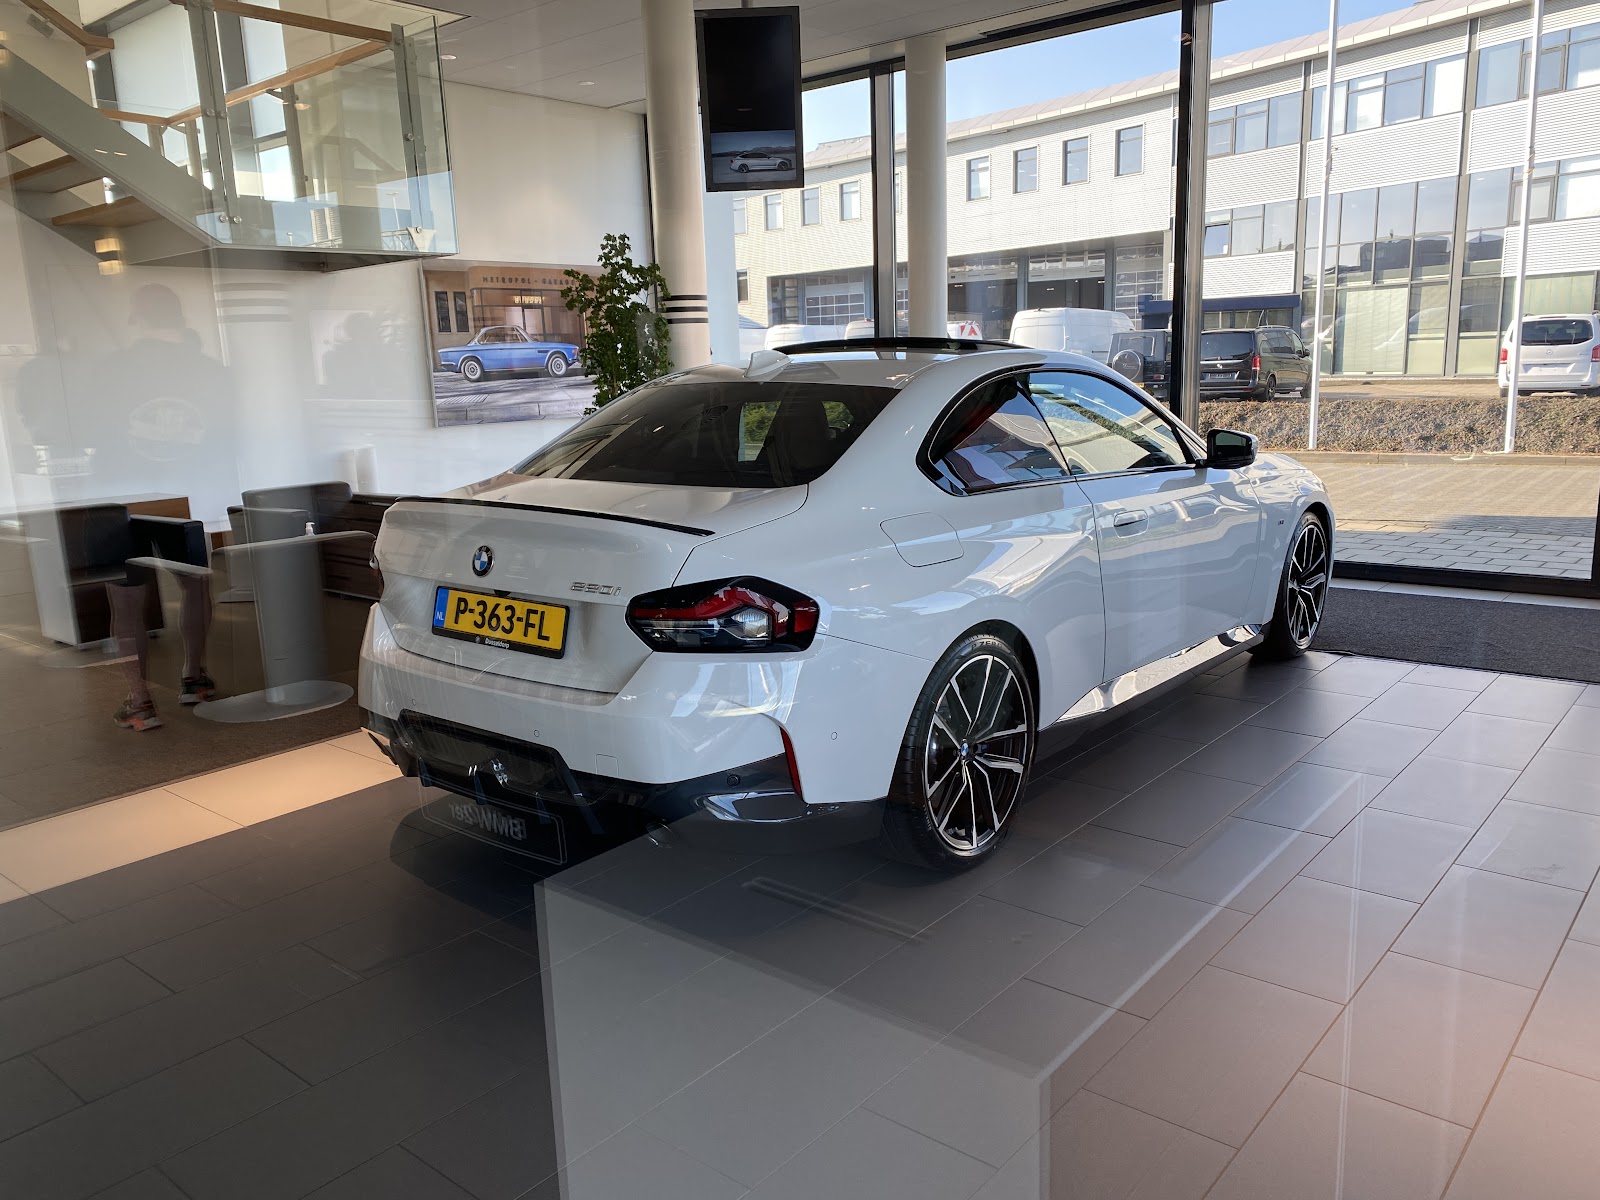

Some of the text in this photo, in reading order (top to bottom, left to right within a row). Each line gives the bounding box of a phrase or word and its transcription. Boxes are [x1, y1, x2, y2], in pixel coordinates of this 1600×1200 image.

[482, 276, 532, 285] METROPOL
[570, 581, 622, 597] 220i
[435, 610, 445, 621] NL
[453, 596, 551, 642] P-363-FL
